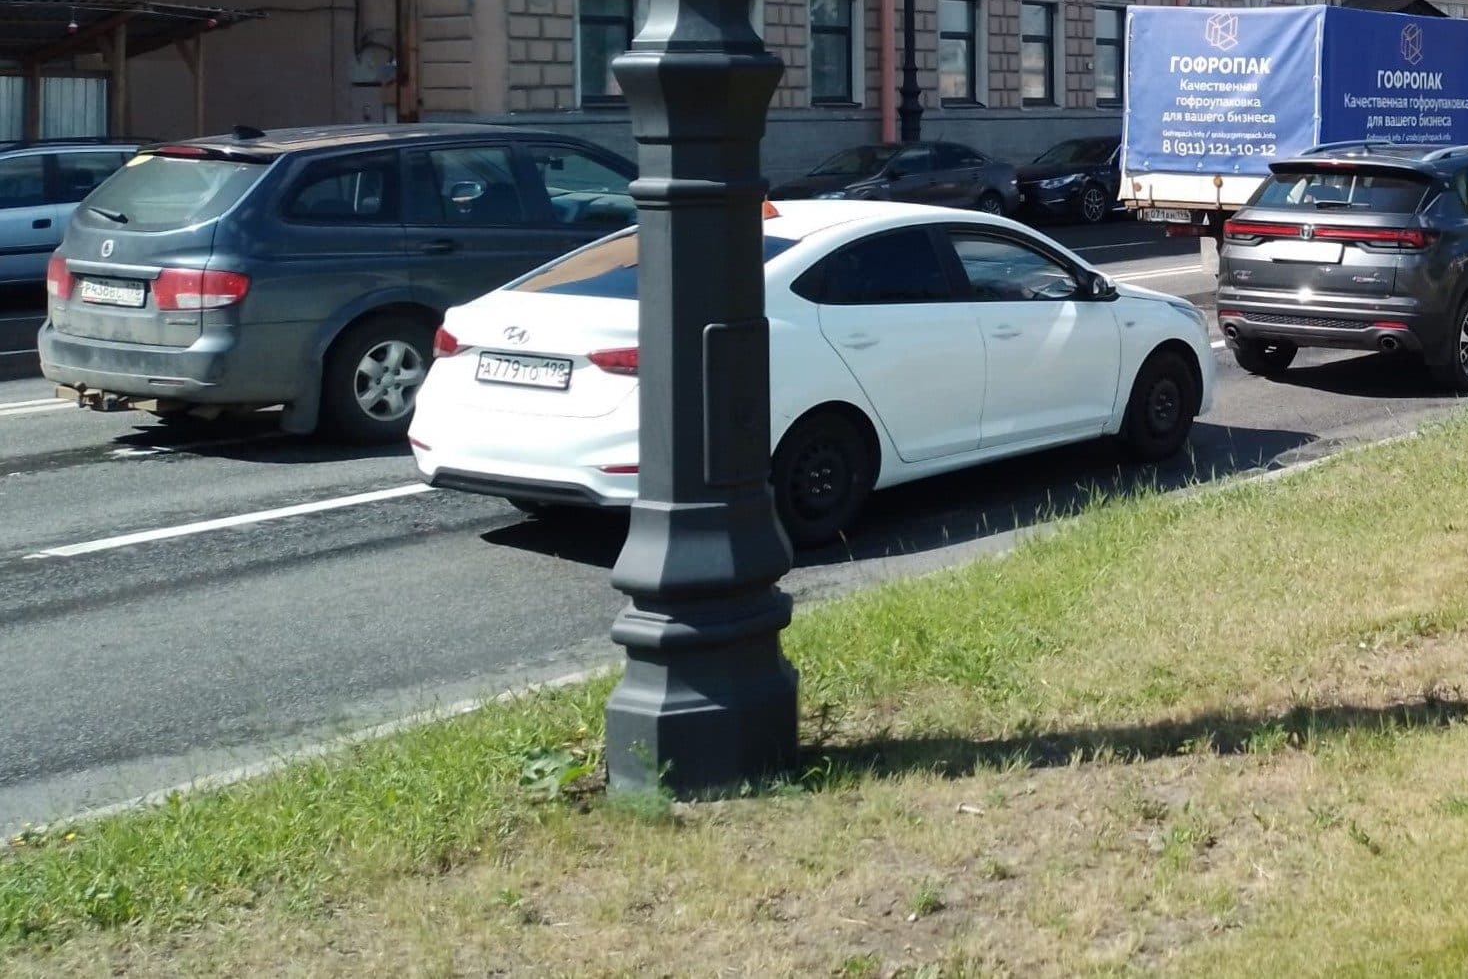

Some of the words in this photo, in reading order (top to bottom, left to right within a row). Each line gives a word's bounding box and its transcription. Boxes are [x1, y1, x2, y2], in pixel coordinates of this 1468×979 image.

[1170, 56, 1272, 74] ГОФРОПАК
[1180, 79, 1257, 92] Качественная
[1377, 70, 1443, 90] ГОФРОПАК
[1176, 95, 1262, 109] гофроупаковка
[1344, 93, 1408, 108] Качественная
[1162, 112, 1182, 122] для
[1185, 113, 1225, 123] вашего
[1227, 111, 1276, 124] бизнеса
[1366, 115, 1383, 128] для
[1385, 116, 1418, 127] вашего
[1419, 114, 1452, 127] бизнеса
[1162, 139, 1172, 154] 8
[1174, 139, 1206, 157] (911)
[1208, 143, 1277, 157] 121-10-12
